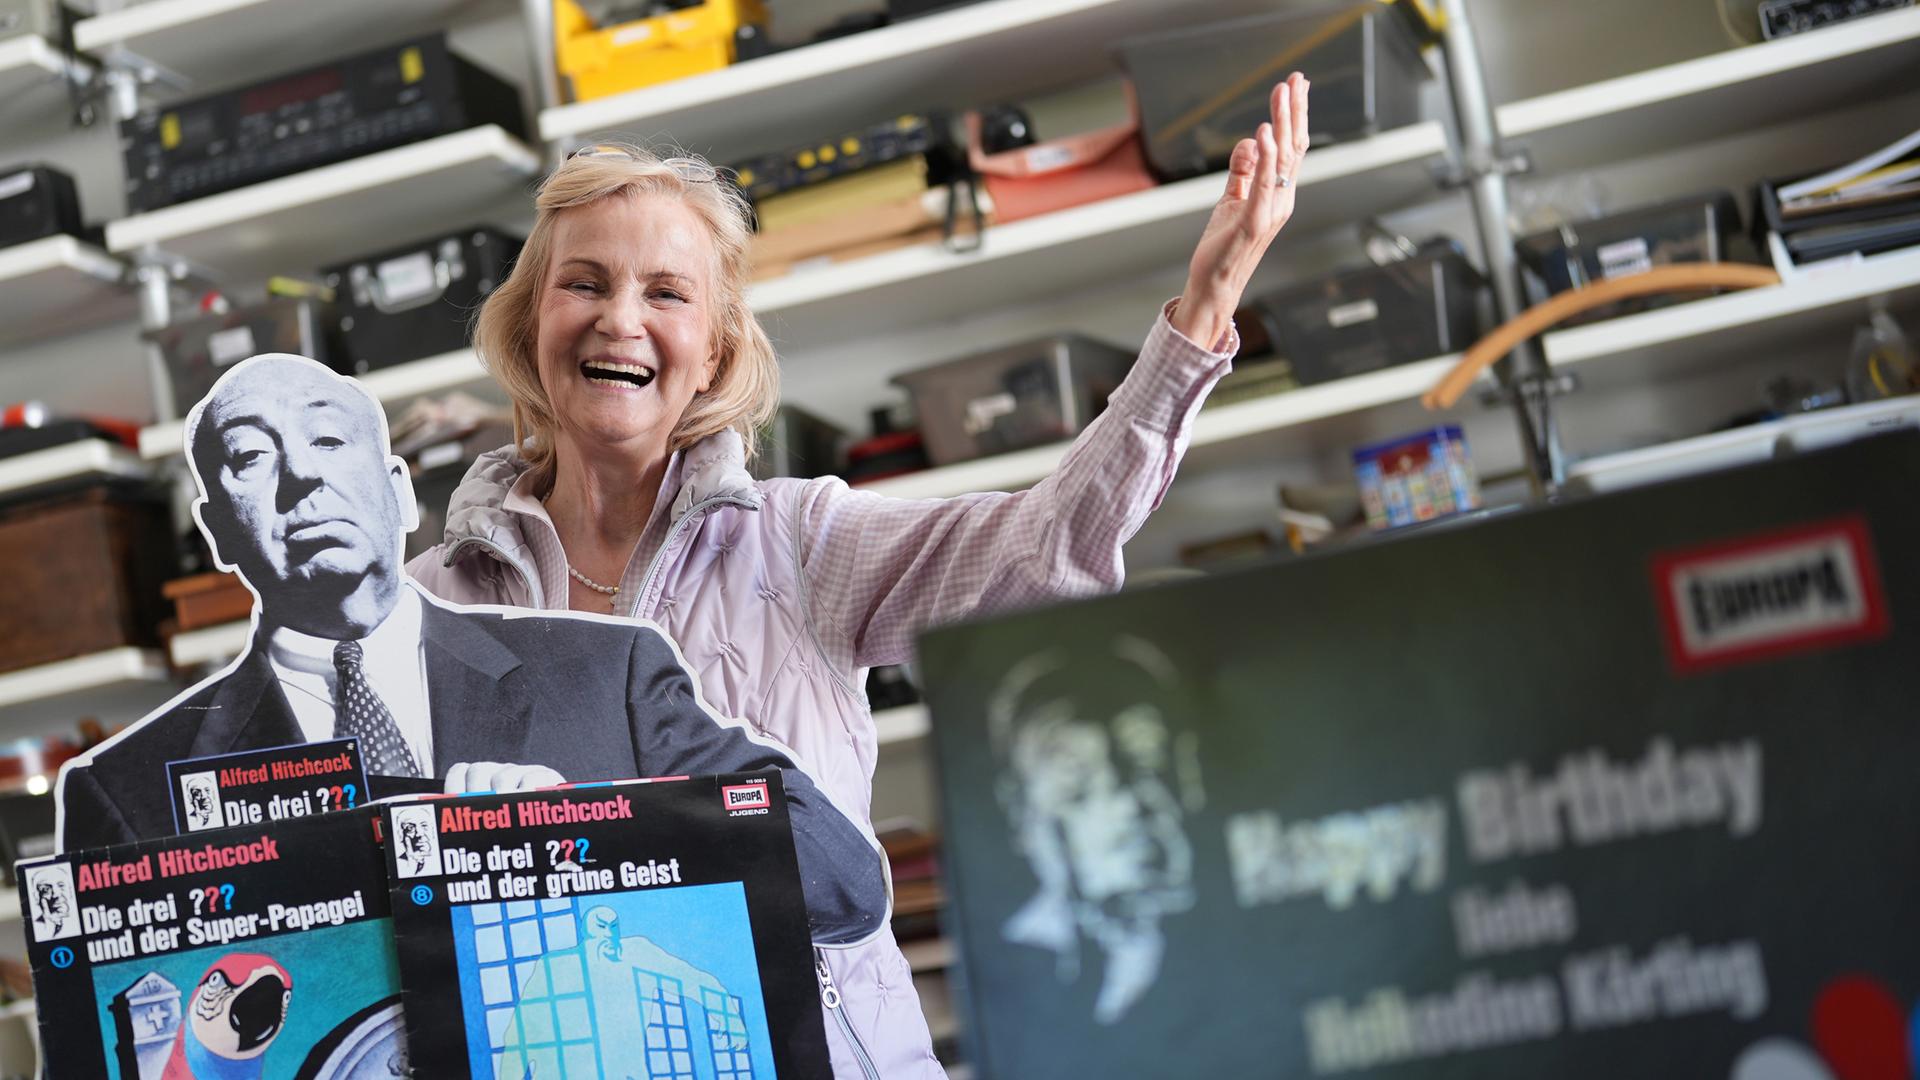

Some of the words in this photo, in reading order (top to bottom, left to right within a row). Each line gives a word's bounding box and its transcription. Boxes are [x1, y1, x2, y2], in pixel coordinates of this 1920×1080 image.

[1689, 550, 1850, 636] EUROPA
[219, 763, 270, 788] Alfred
[271, 752, 353, 781] Hitchcock
[224, 799, 263, 827] Die
[267, 790, 313, 819] drei
[316, 783, 357, 813] ???
[440, 803, 512, 834] Alfred
[517, 794, 634, 827] Hitchcock
[729, 790, 763, 804] EUROPA
[729, 808, 769, 817] JUGEND
[1227, 798, 1447, 907] Happy
[1459, 737, 1761, 863] Birthday
[78, 855, 154, 892] Alfred
[157, 835, 280, 879] Hitchcock
[442, 846, 482, 875] Die
[486, 842, 535, 872] drei
[545, 837, 590, 866] ???
[446, 873, 492, 903] und
[497, 872, 538, 898] der
[545, 867, 615, 898] grüne
[619, 858, 682, 888] Geist
[81, 904, 123, 934] Die
[127, 893, 178, 922] drei
[188, 883, 236, 915] ???
[86, 924, 136, 963] und
[139, 922, 181, 954] der
[186, 890, 366, 945] Super-Papagei
